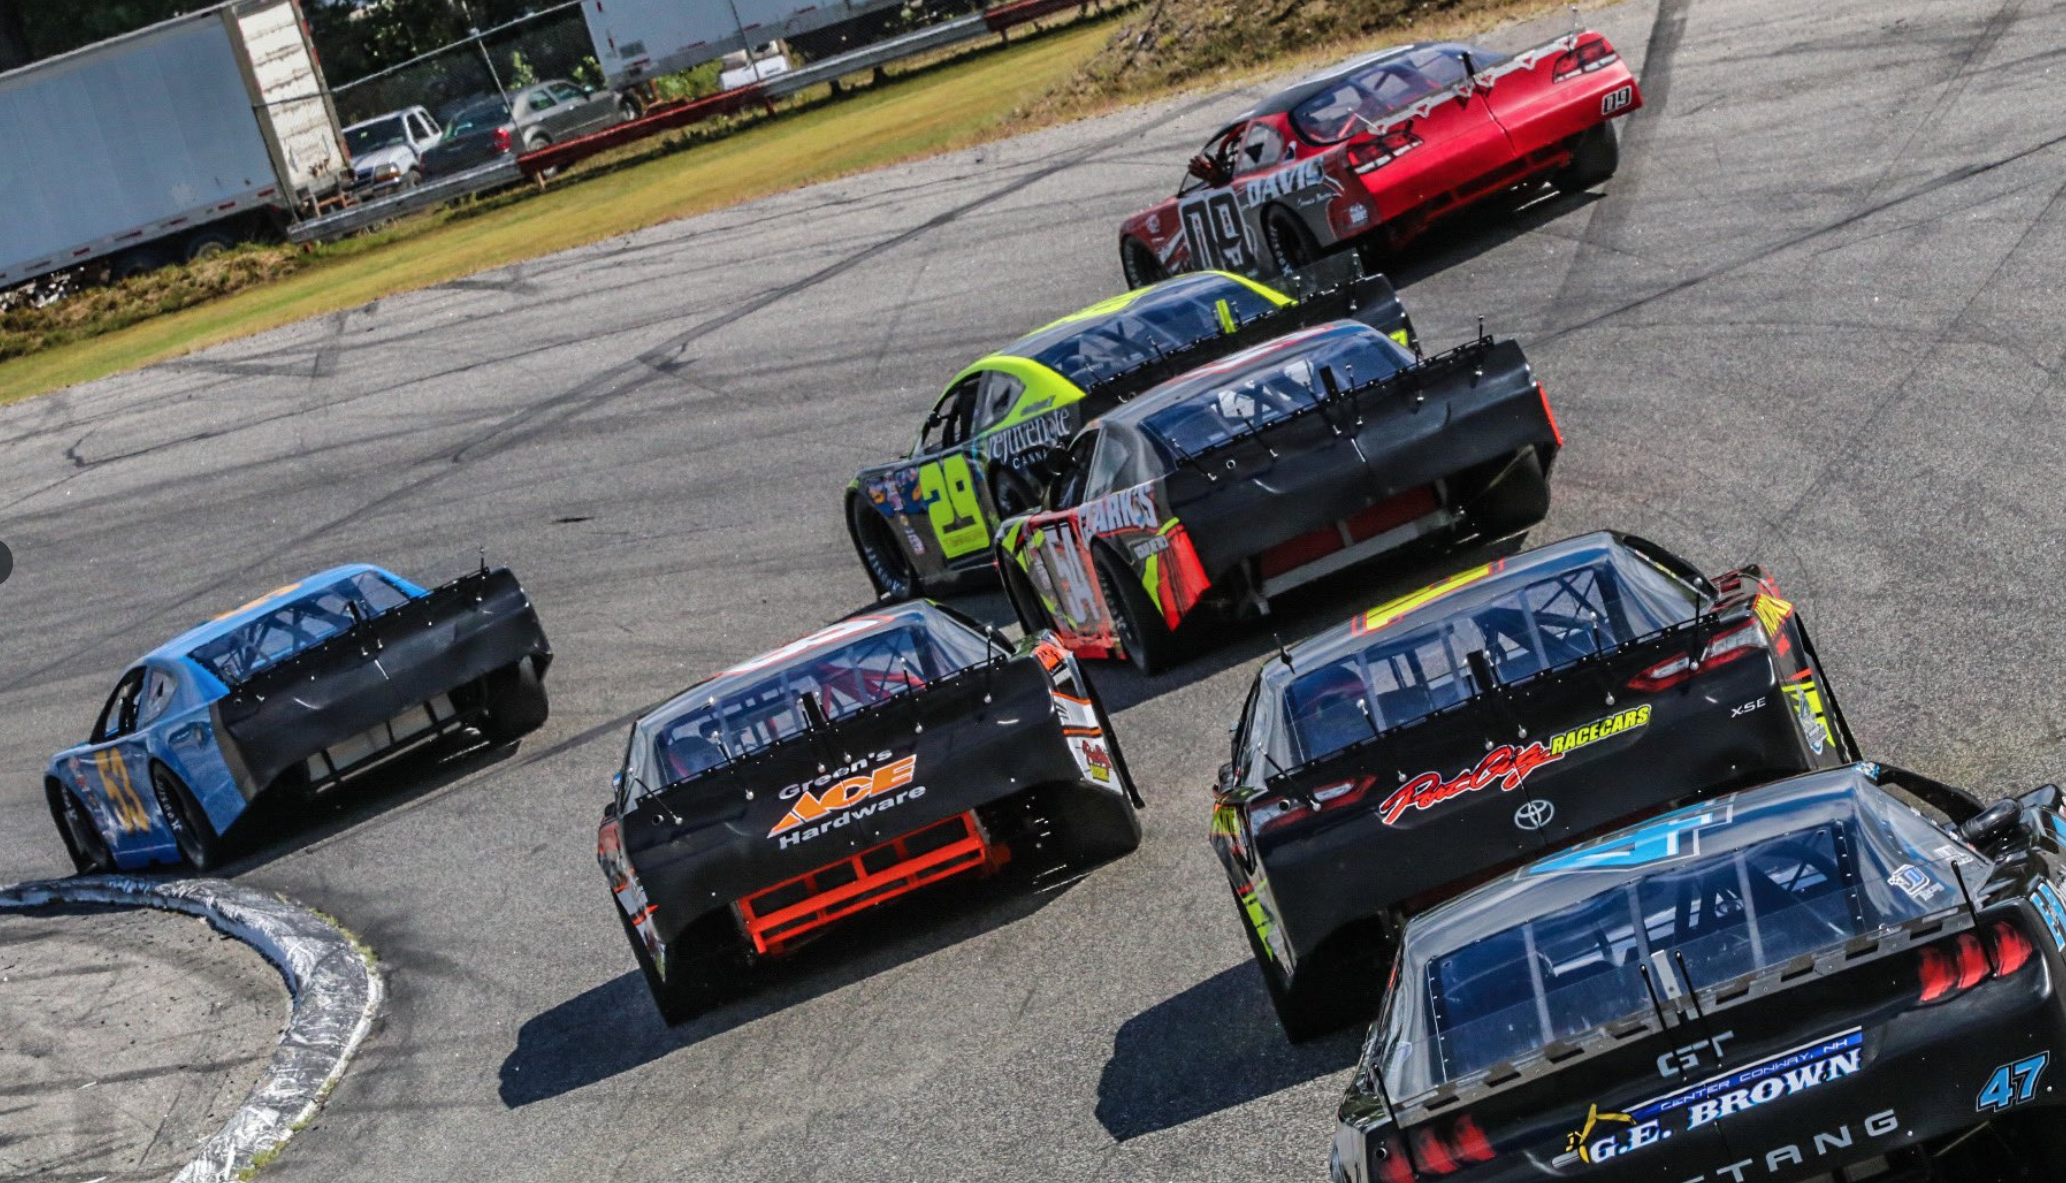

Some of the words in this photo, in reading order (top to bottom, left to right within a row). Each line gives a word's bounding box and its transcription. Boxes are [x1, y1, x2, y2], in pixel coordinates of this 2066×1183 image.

[1603, 87, 1630, 114] 09
[919, 453, 990, 559] 29
[1550, 703, 1652, 757] RACECARS
[1731, 697, 1766, 718] XSE
[766, 754, 918, 839] ACE
[778, 750, 893, 800] Green's
[779, 785, 926, 850] Hardware
[1656, 1030, 1735, 1078] GT
[1660, 1079, 1731, 1111] CENTER
[1823, 1038, 1848, 1053] NH
[1976, 1050, 2050, 1113] 47
[1589, 1118, 1673, 1164] G.E.
[1686, 1047, 1862, 1132] BROWN
